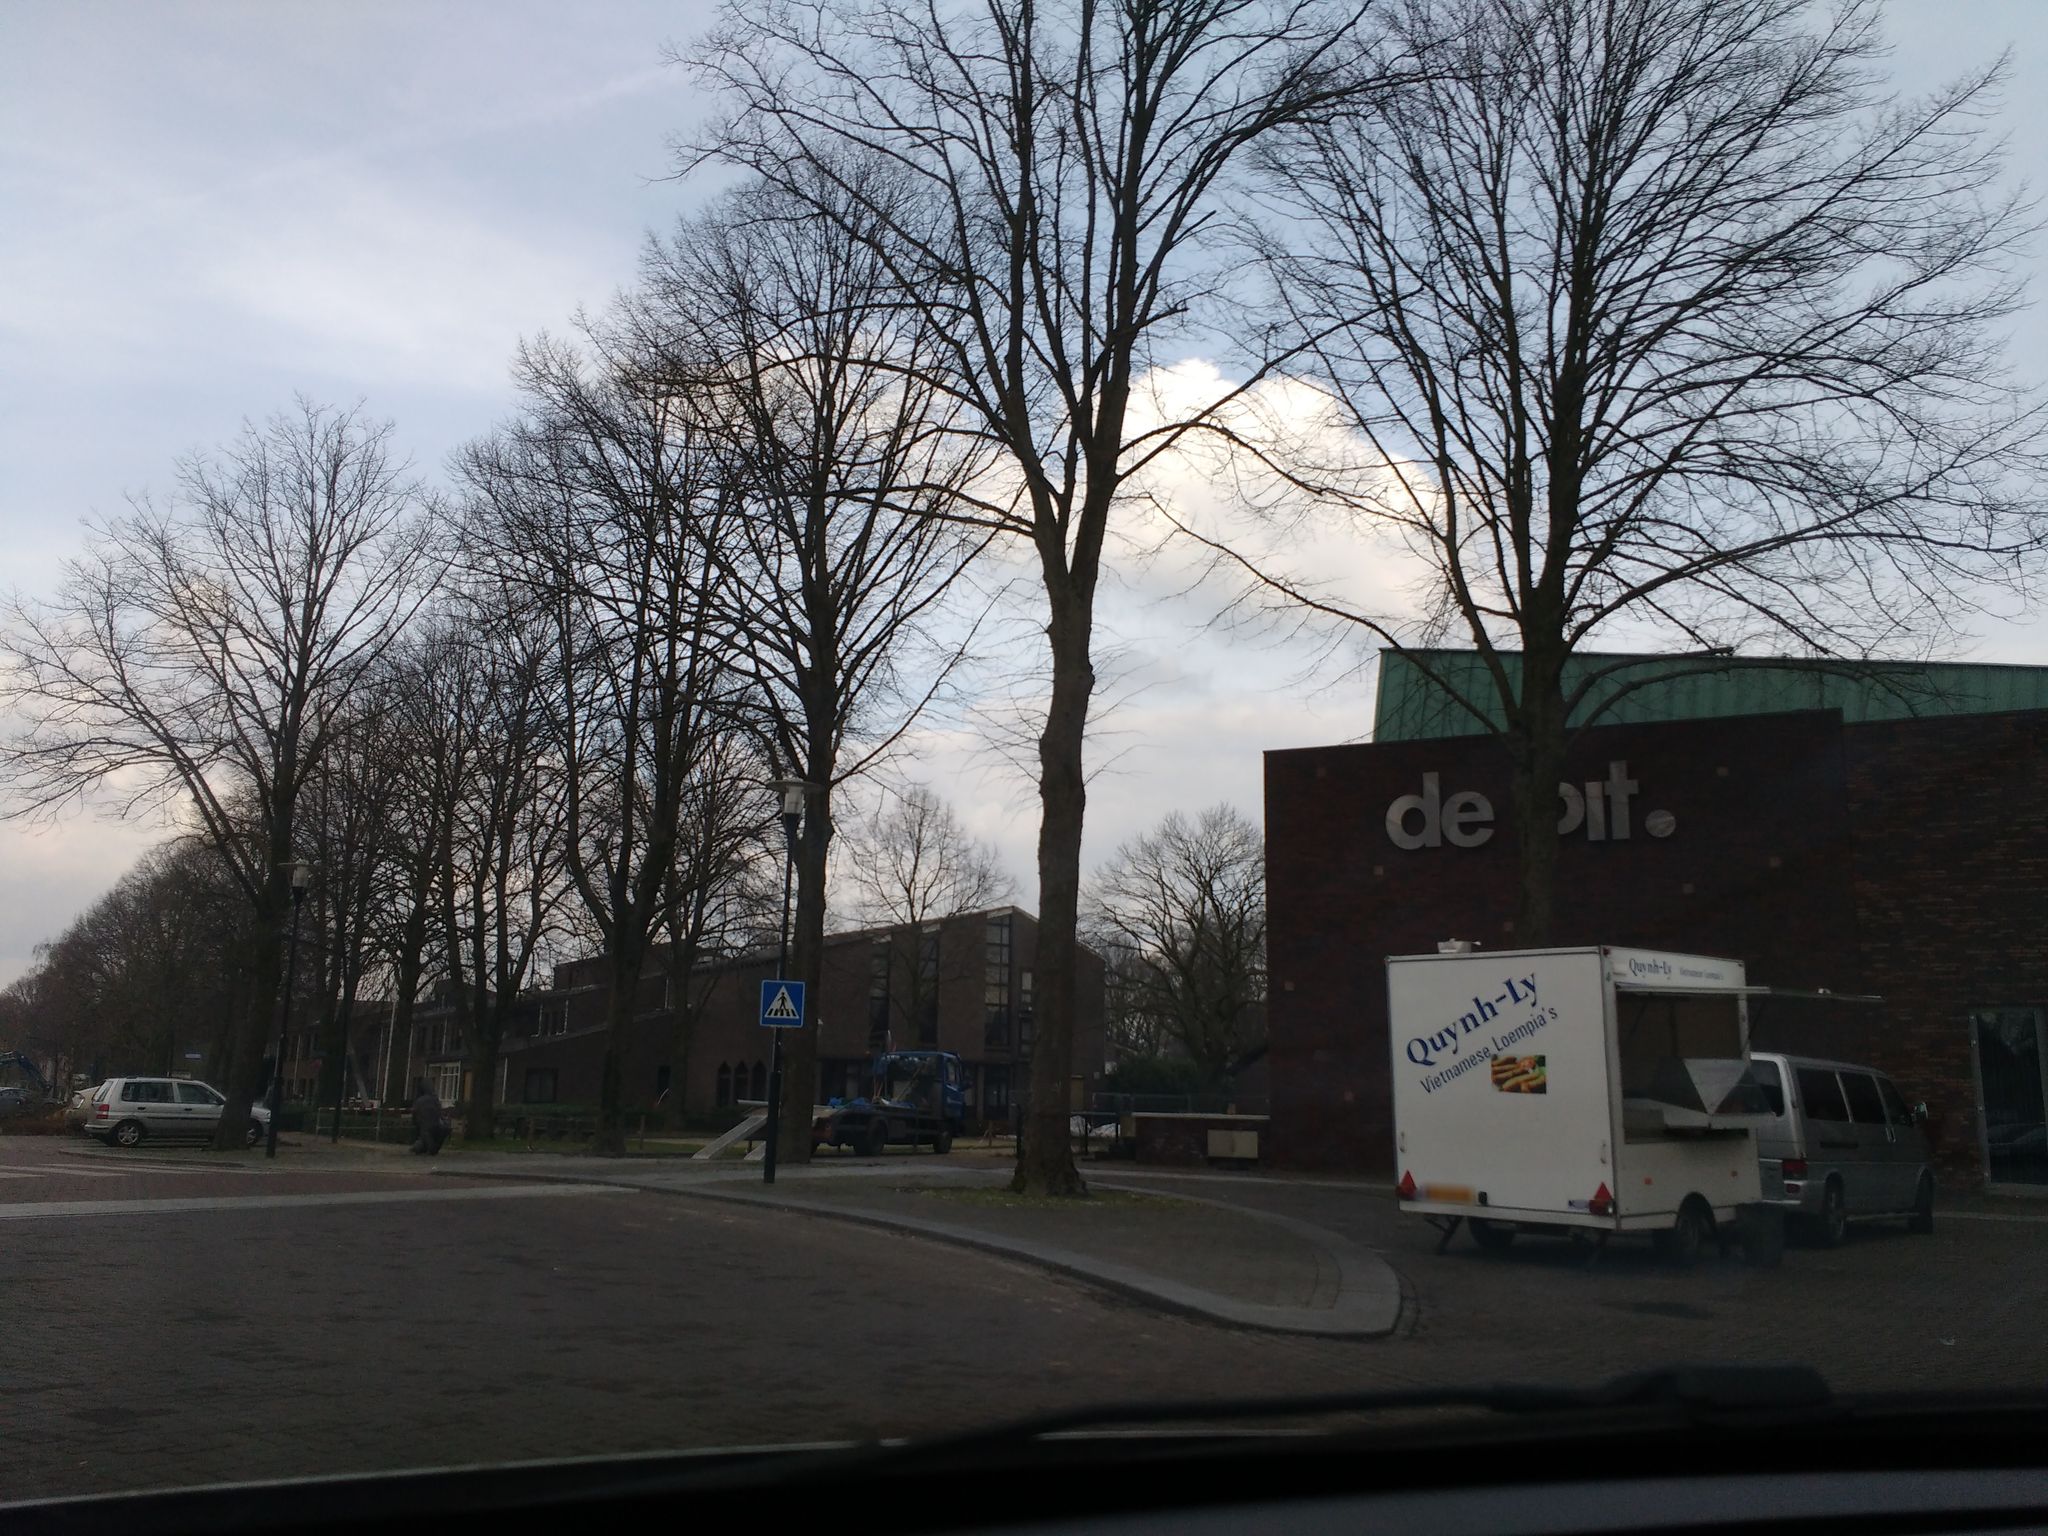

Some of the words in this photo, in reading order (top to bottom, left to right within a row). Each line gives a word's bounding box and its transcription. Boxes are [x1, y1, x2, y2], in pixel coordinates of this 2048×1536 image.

[1385, 771, 1495, 850] de
[1406, 972, 1538, 1067] Quynh-Ly
[1420, 1045, 1492, 1094] Vietnamese
[1491, 1006, 1558, 1052] Loempia's
